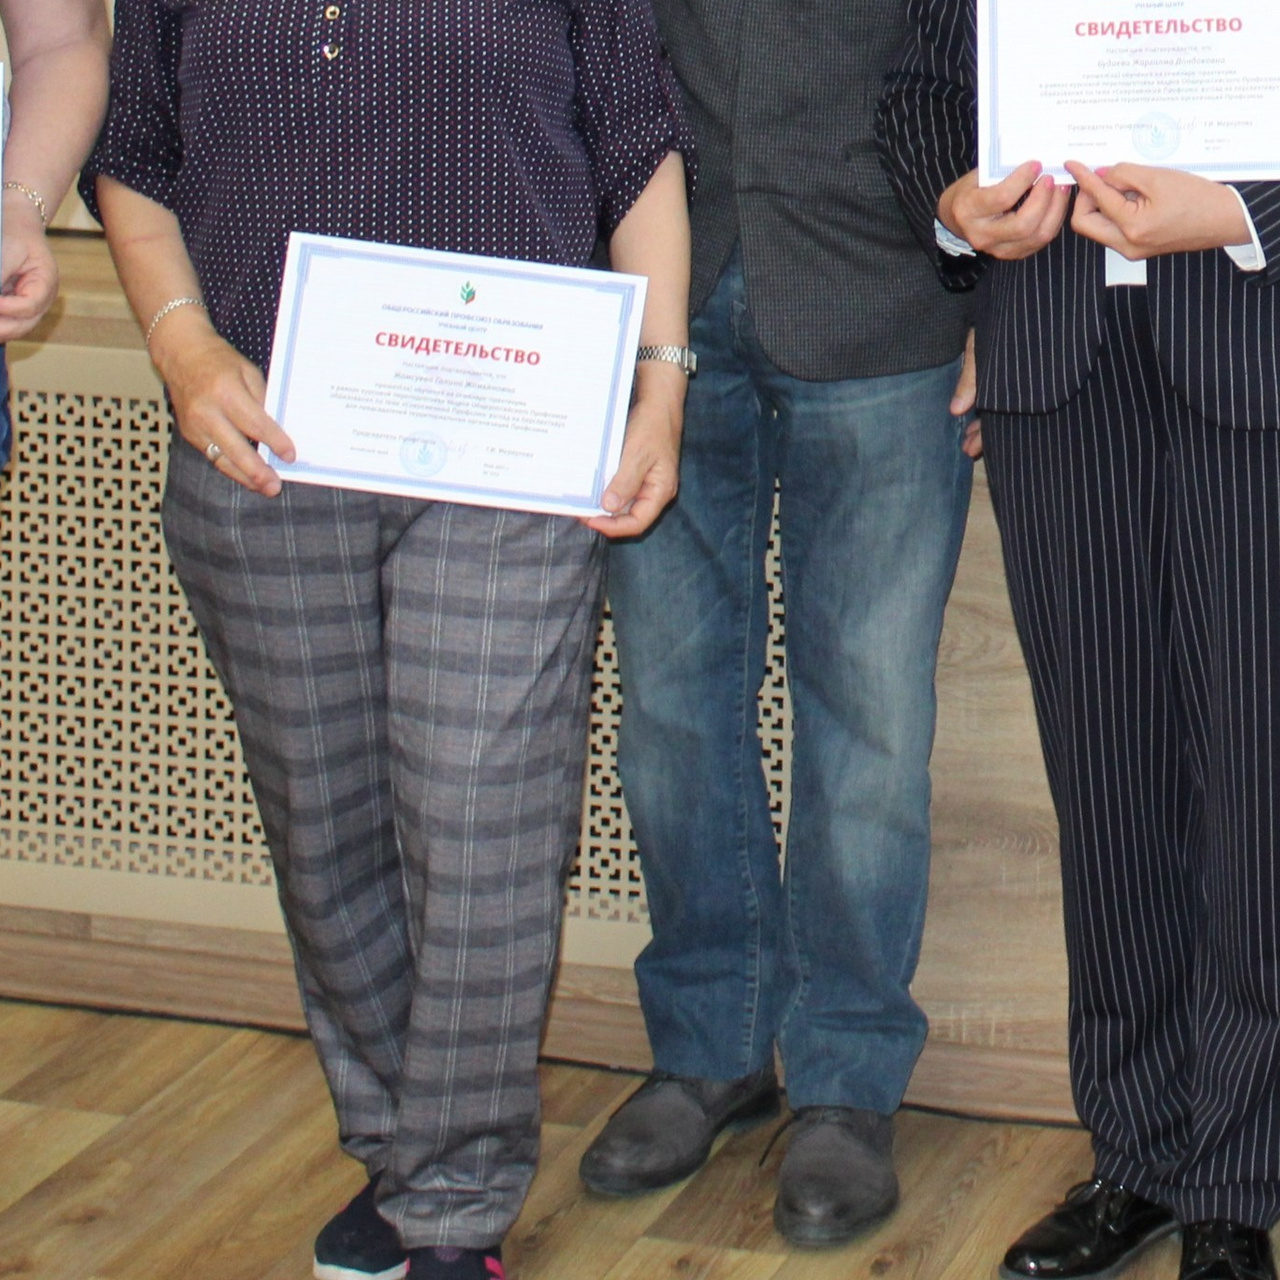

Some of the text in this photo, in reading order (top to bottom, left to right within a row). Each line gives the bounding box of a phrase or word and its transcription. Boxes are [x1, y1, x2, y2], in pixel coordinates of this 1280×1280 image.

[1074, 17, 1243, 39] СВИДЕТЕЛЬСТВО
[450, 312, 492, 323] ПРОФСОЮЗ
[374, 330, 541, 366] СВИДЕТЕЛЬСТВО
